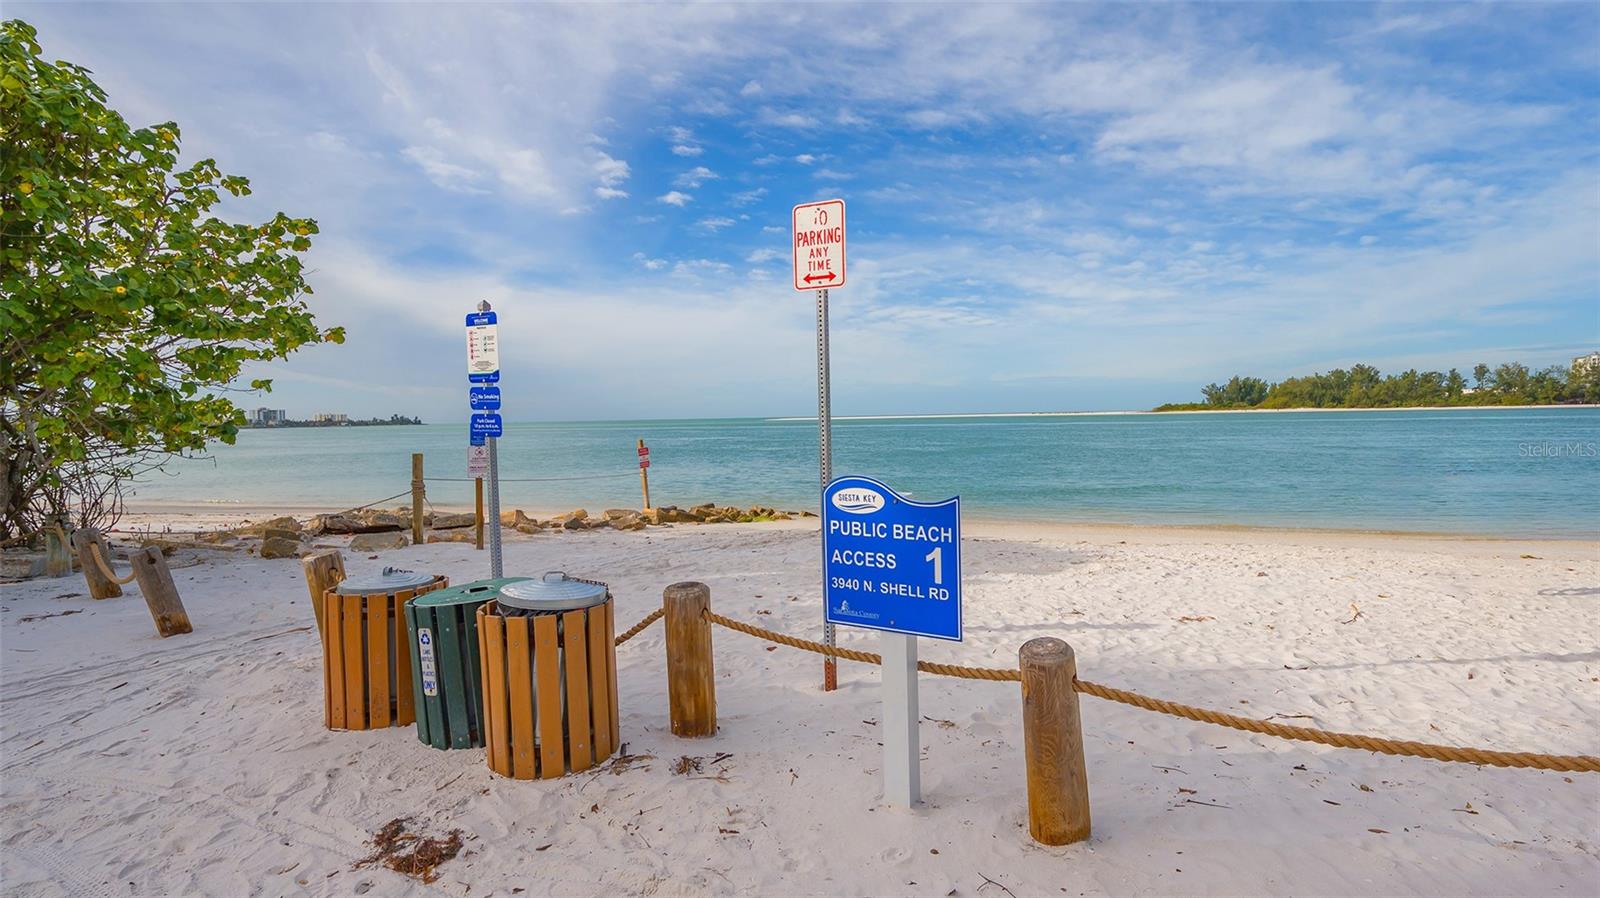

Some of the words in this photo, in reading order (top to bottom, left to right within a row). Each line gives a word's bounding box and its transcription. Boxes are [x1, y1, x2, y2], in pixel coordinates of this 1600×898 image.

[797, 227, 841, 248] PARKING
[809, 246, 829, 259] ANY
[808, 259, 831, 272] TIME
[838, 493, 860, 502] SIESTA
[863, 494, 876, 503] KEY
[830, 520, 887, 538] PUBLIC
[893, 524, 952, 542] BEACH
[832, 550, 896, 569] ACCESS
[925, 547, 942, 584] 1
[832, 577, 859, 589] 3940
[864, 581, 876, 592] N.
[880, 583, 925, 598] SHELL
[929, 588, 949, 600] RD
